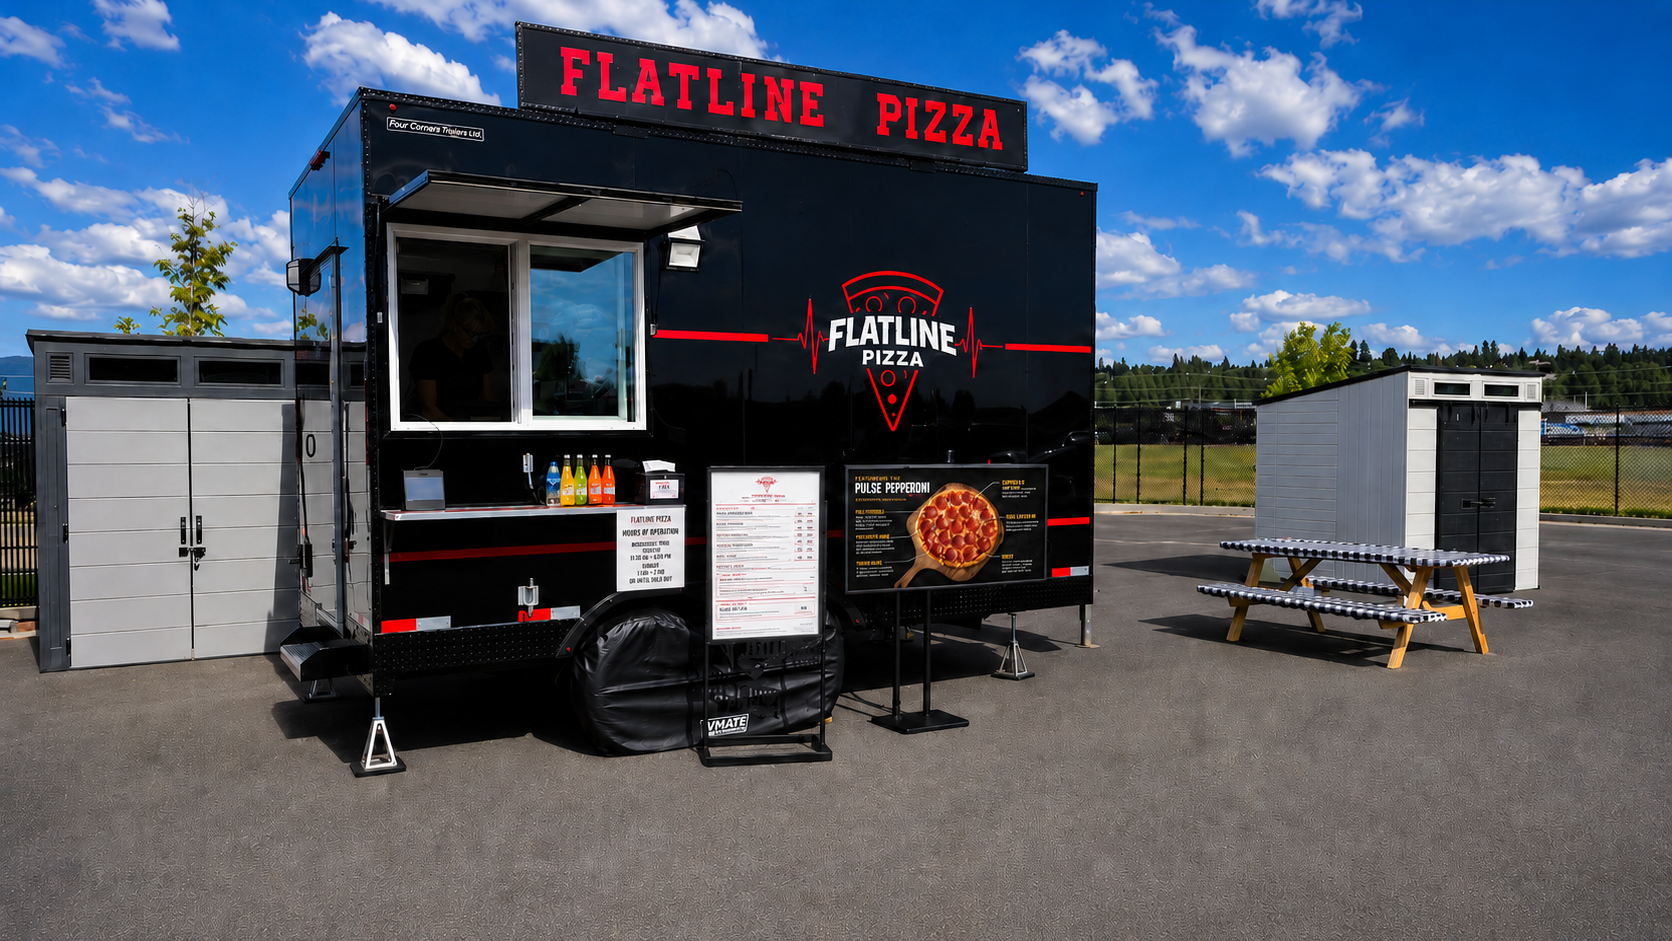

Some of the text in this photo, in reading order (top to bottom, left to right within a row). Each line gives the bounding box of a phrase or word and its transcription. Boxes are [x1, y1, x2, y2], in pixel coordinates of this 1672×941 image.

[560, 46, 1004, 151] FLATLINE PIZZA
[389, 119, 409, 129] Four
[410, 122, 441, 133] Corners
[828, 315, 958, 356] FLATLINE
[862, 349, 924, 368] PIZZA
[855, 481, 930, 494] PULSE PEPPERONI
[707, 716, 747, 731] VMATE
